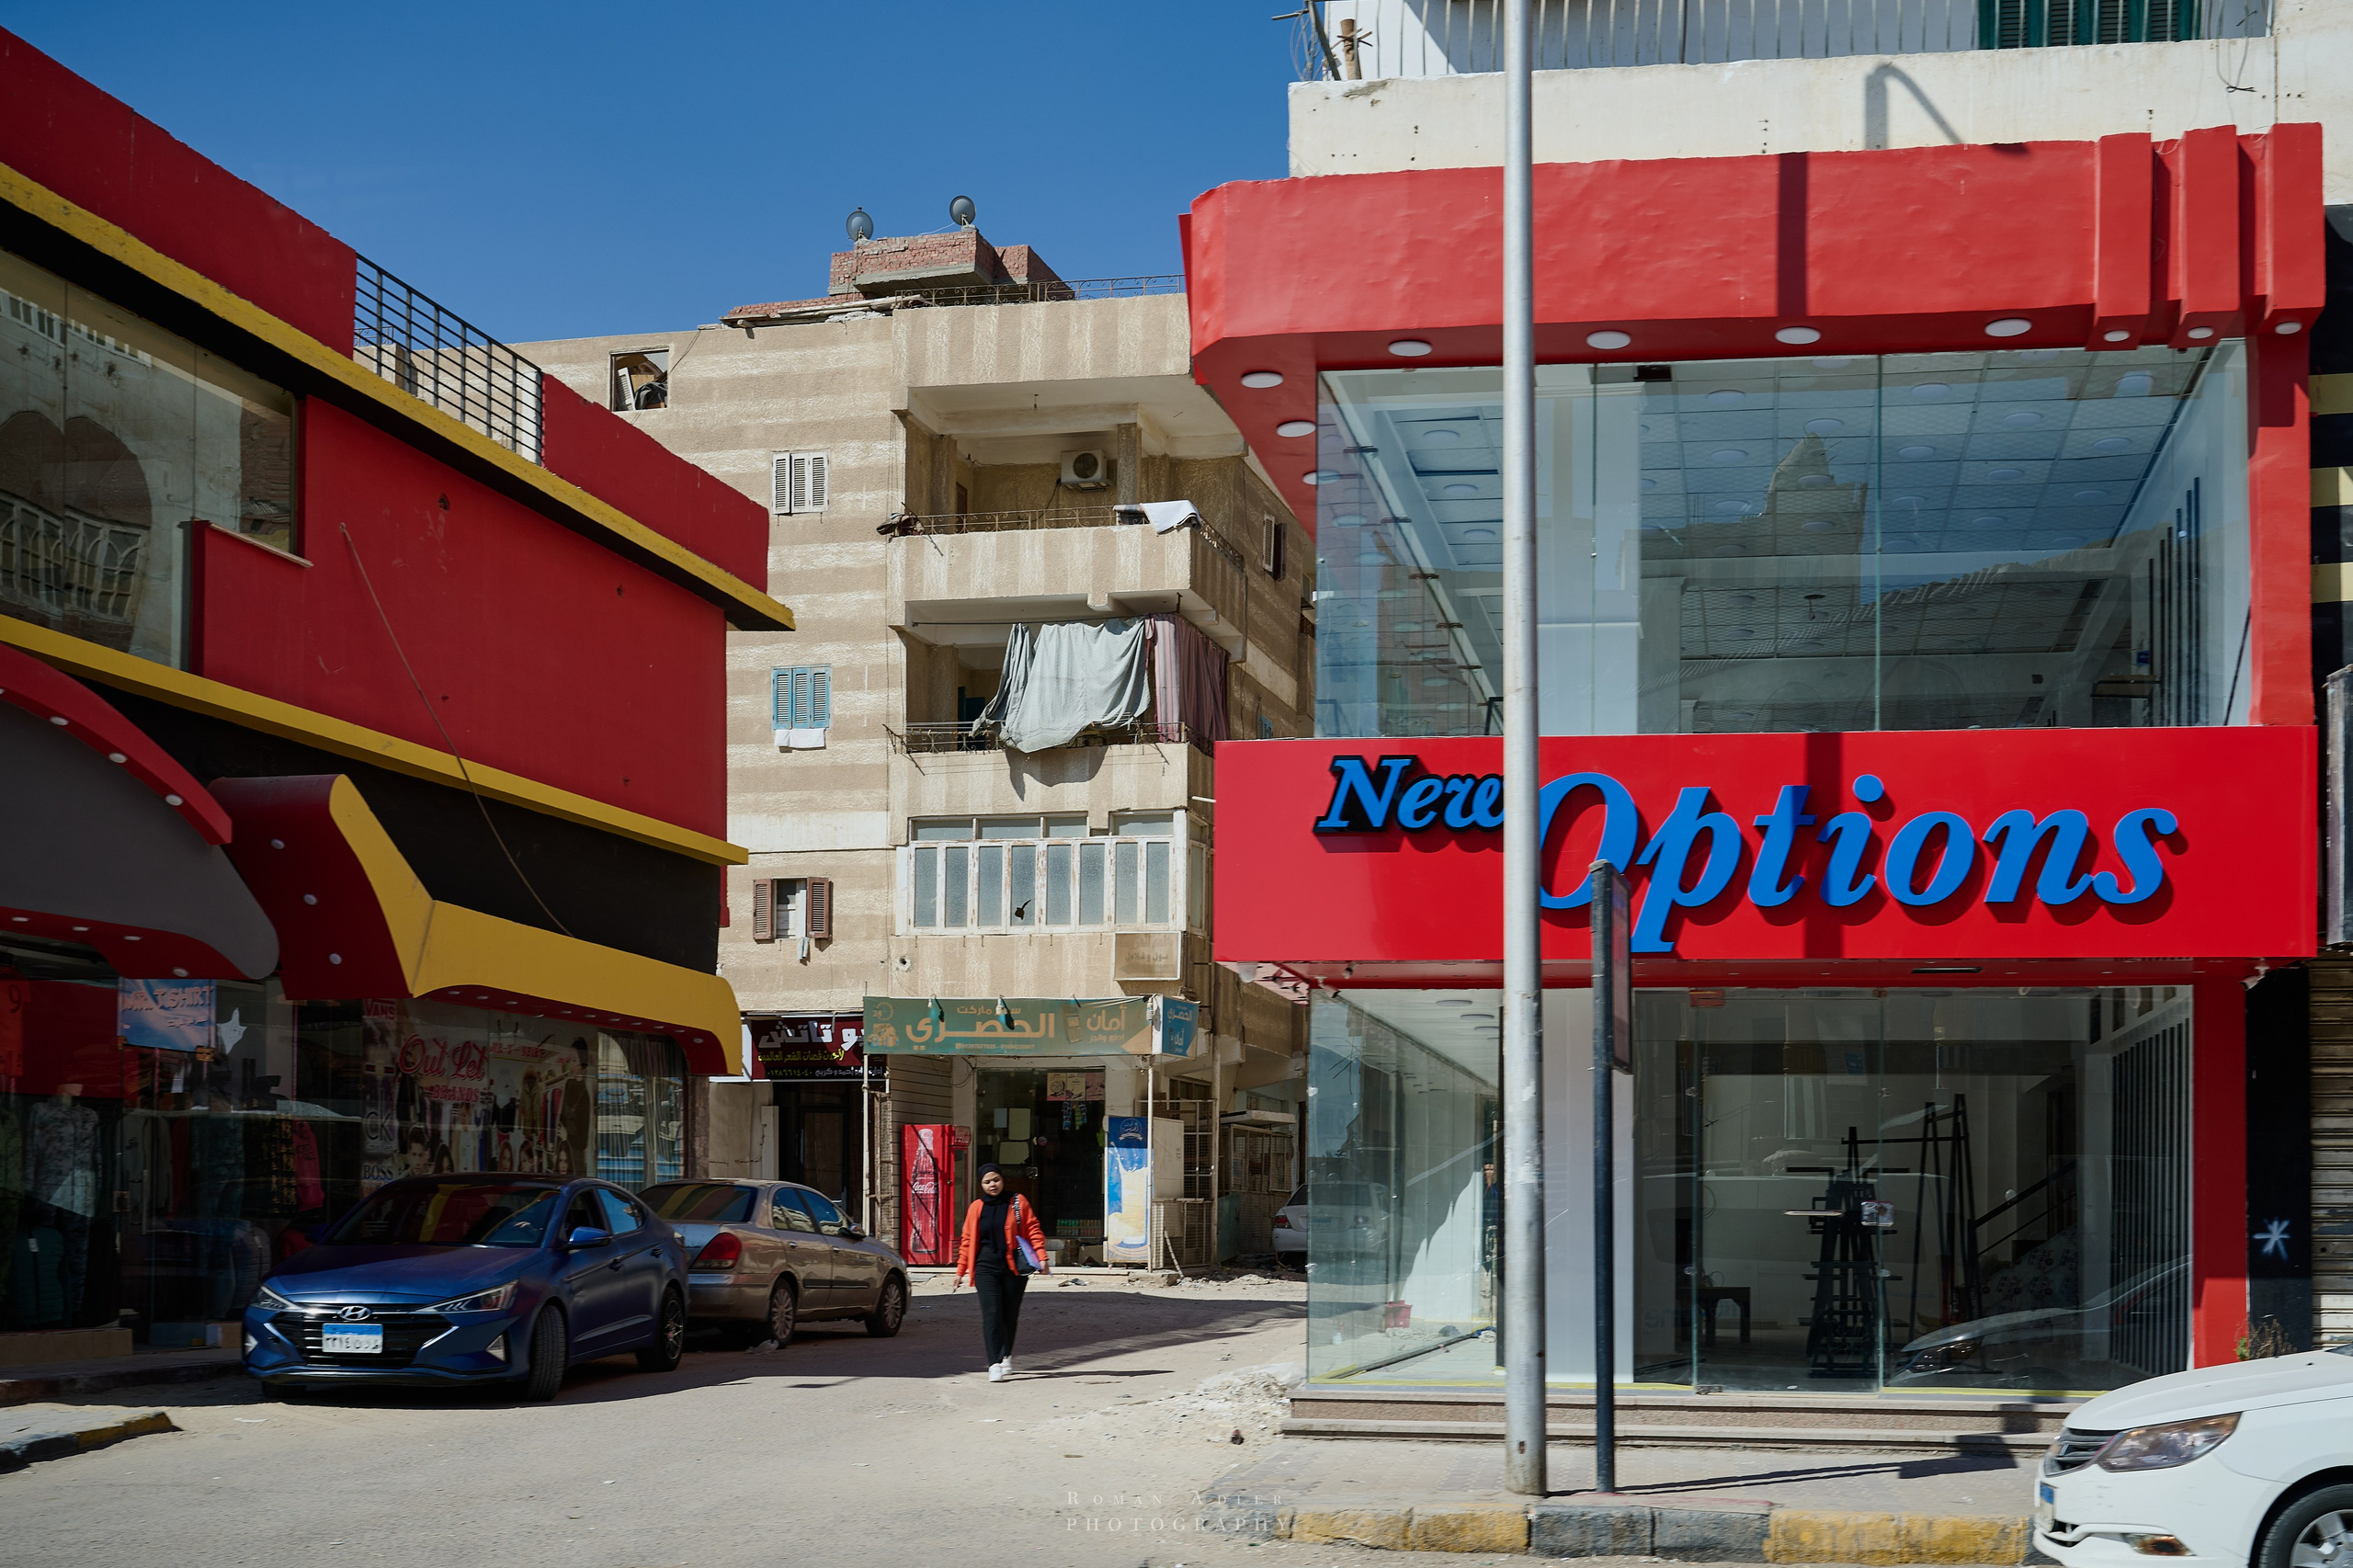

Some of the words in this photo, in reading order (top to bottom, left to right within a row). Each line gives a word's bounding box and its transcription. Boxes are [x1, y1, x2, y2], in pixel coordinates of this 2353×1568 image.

[1313, 756, 1504, 832] New
[1539, 770, 2177, 953] Options
[364, 997, 395, 1020] VANS
[957, 1006, 992, 1017] ماركت
[1086, 1006, 1127, 1031] أمان
[758, 1020, 833, 1049] تاتش
[905, 1013, 1055, 1051] الحصري
[400, 1034, 449, 1075] Out
[451, 1040, 487, 1081] Let
[783, 1050, 801, 1062] الشعر
[432, 1085, 479, 1103] BRANDS
[366, 1110, 393, 1142] CK
[363, 1165, 393, 1180] BOSS
